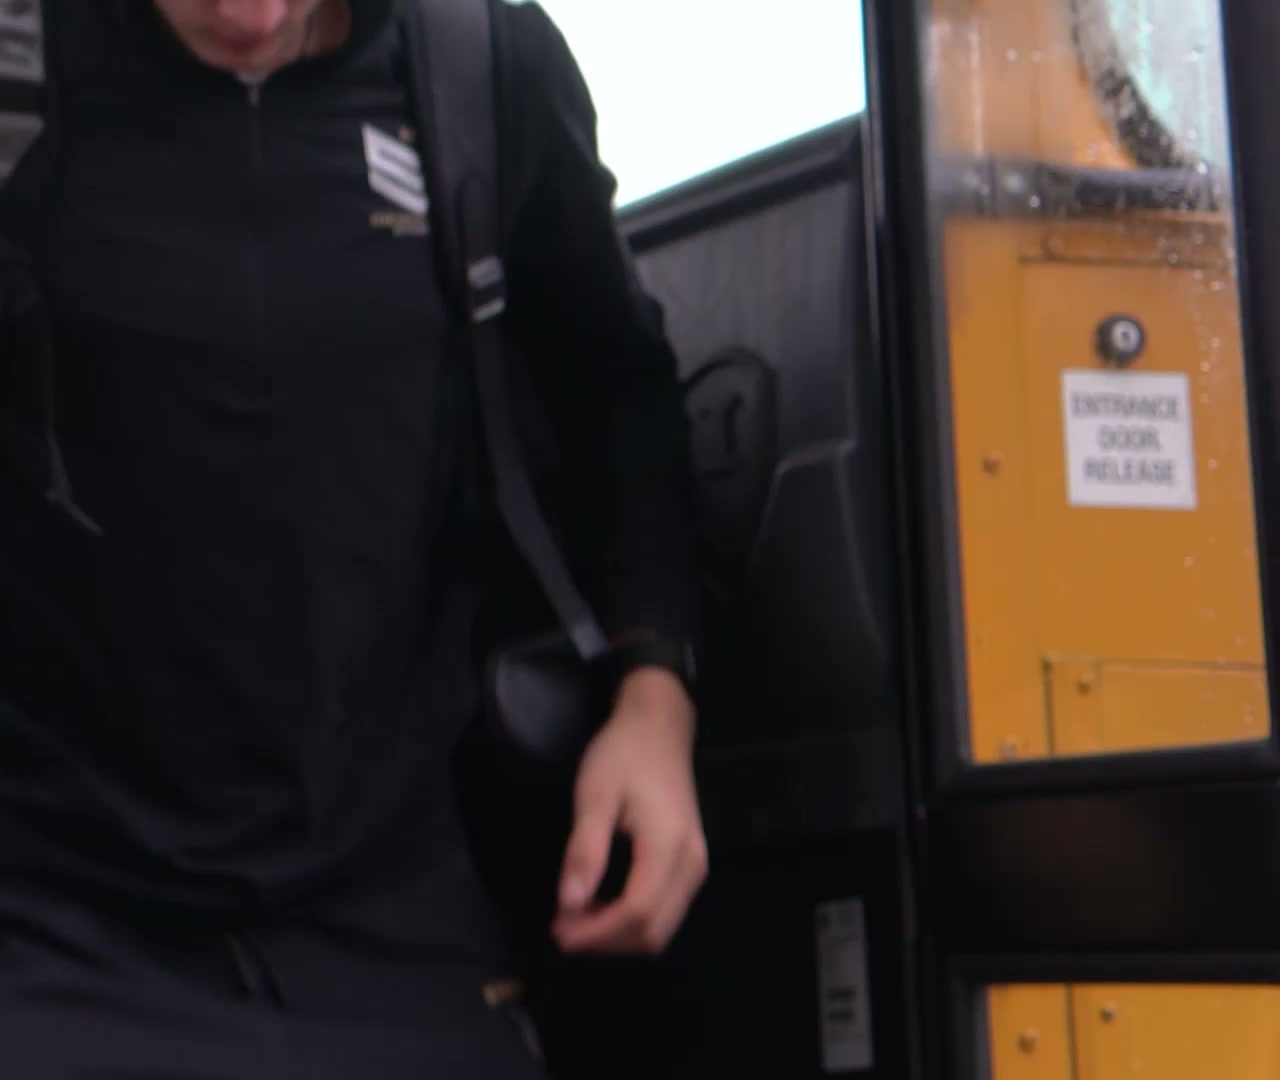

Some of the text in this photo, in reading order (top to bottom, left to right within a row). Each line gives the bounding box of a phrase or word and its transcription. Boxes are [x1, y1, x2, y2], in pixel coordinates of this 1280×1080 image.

[1072, 392, 1178, 420] ENTRANCE
[1098, 425, 1161, 451] DOOR
[1083, 457, 1175, 485] RELEASE
